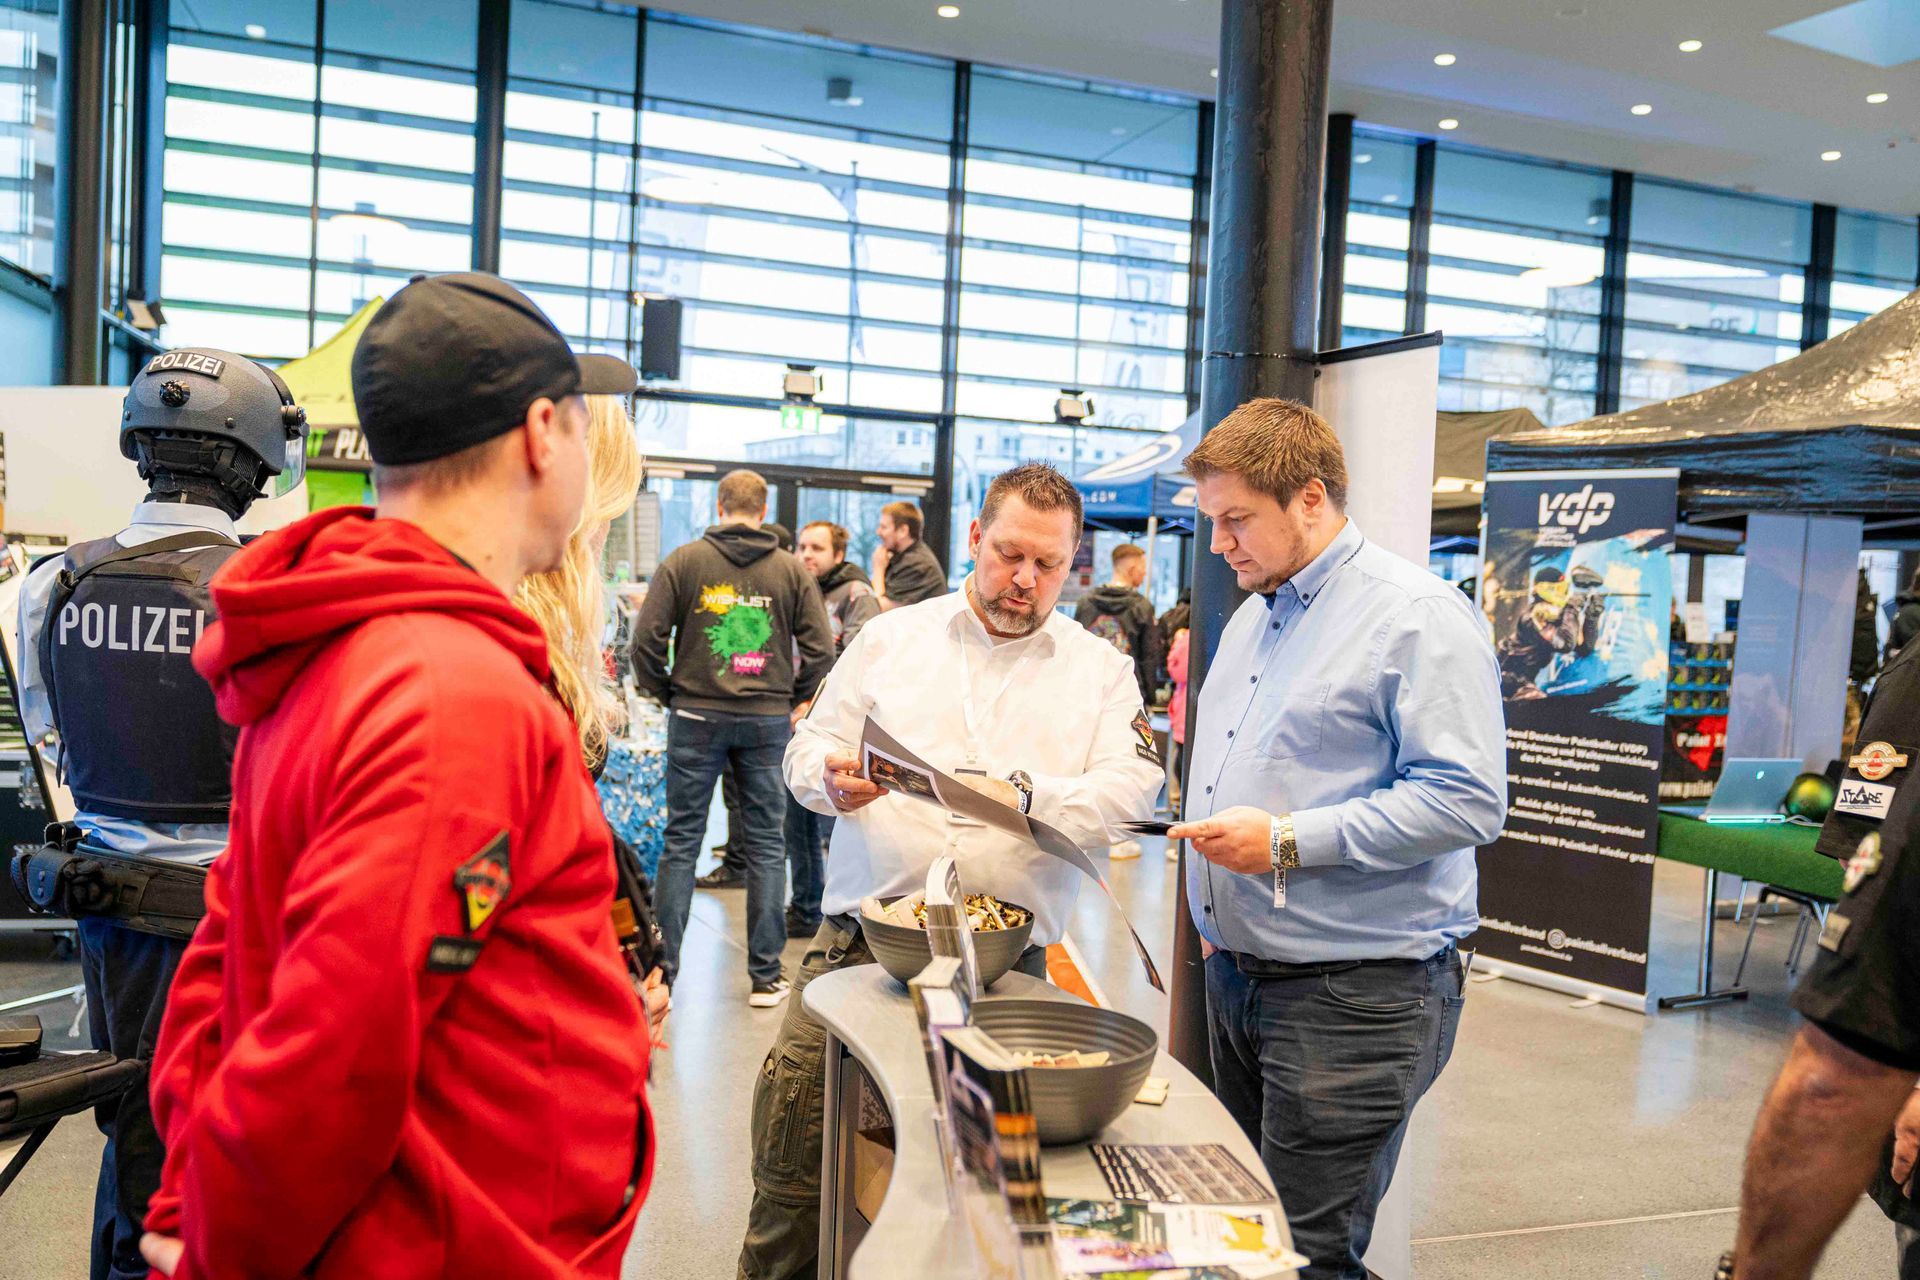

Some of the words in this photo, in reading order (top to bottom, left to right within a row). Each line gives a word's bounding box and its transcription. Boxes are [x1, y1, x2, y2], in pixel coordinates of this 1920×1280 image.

[149, 353, 222, 375] POLIZEI
[59, 602, 204, 654] POLIZEI
[734, 656, 765, 668] NOW
